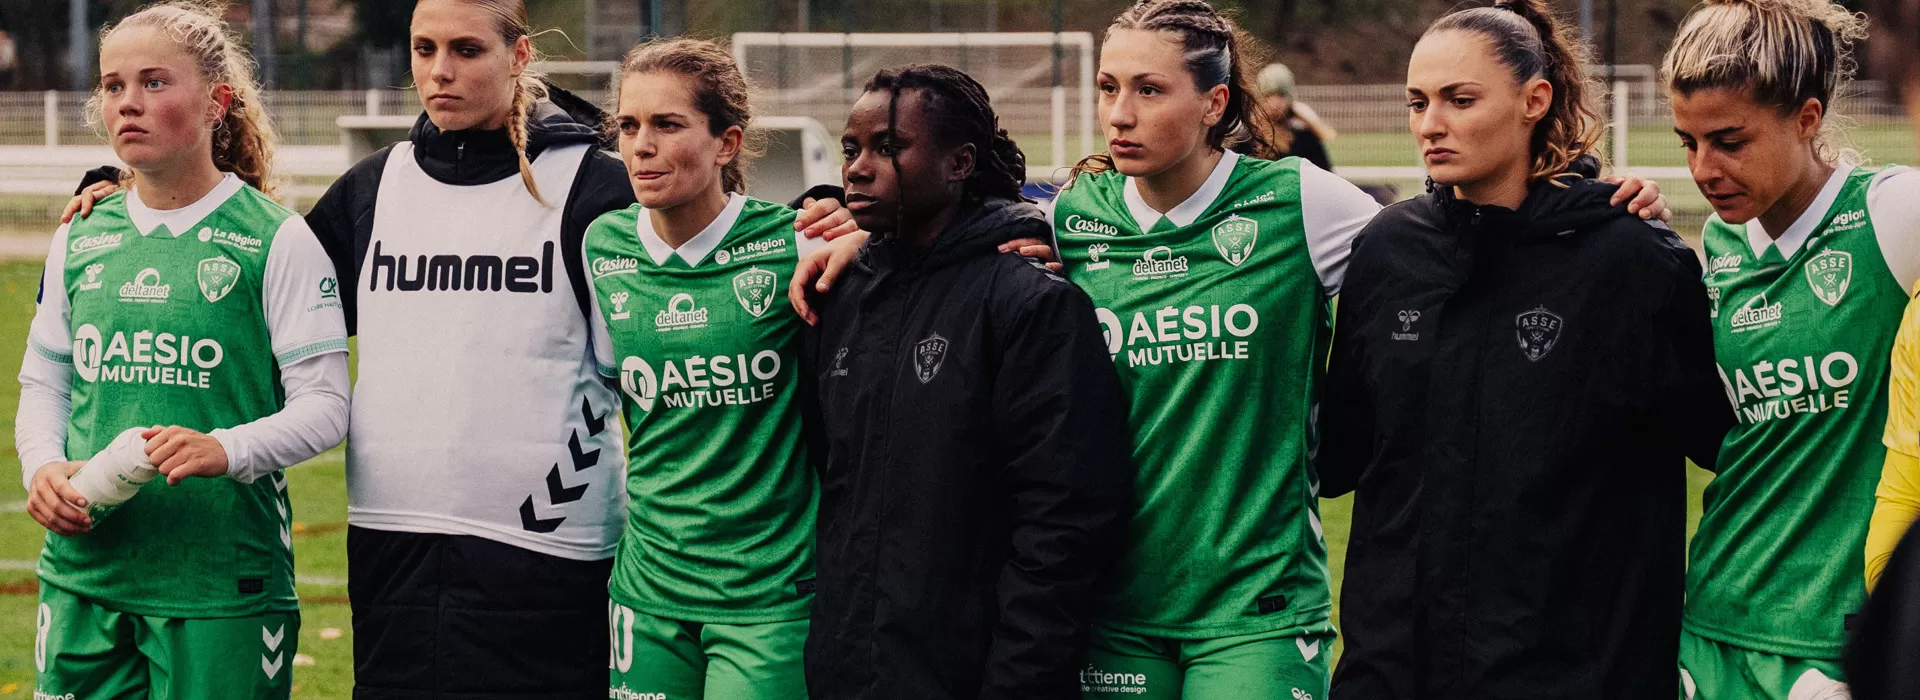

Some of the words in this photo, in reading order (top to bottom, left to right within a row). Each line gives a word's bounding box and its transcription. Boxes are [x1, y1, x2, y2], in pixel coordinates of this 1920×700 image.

[1065, 214, 1118, 237] Casino
[1831, 210, 1865, 225] égion
[214, 228, 227, 237] La
[227, 232, 262, 247] Région
[1218, 223, 1253, 236] ASSE
[71, 232, 122, 252] Casino
[732, 246, 745, 255] La
[747, 238, 786, 252] Région
[203, 263, 235, 277] ASSE
[370, 240, 555, 294] hummel
[592, 255, 639, 276] Casino
[1134, 258, 1187, 274] deltanet
[1811, 257, 1846, 274] ASSE
[120, 283, 169, 297] deltanet
[740, 275, 771, 288] ASSE
[656, 309, 706, 325] deltanet
[1127, 303, 1259, 345] AÉSIO
[1522, 316, 1557, 329] ASSE
[103, 329, 224, 369] AÉSIO
[920, 342, 945, 354] ASSE
[1128, 340, 1249, 367] MUTUELLE
[101, 364, 211, 388] MUTUELLE
[661, 349, 781, 391] AÉSIO
[1736, 351, 1859, 404] AÉSIO
[662, 382, 775, 409] MUTUELLE
[1120, 685, 1147, 694] design
